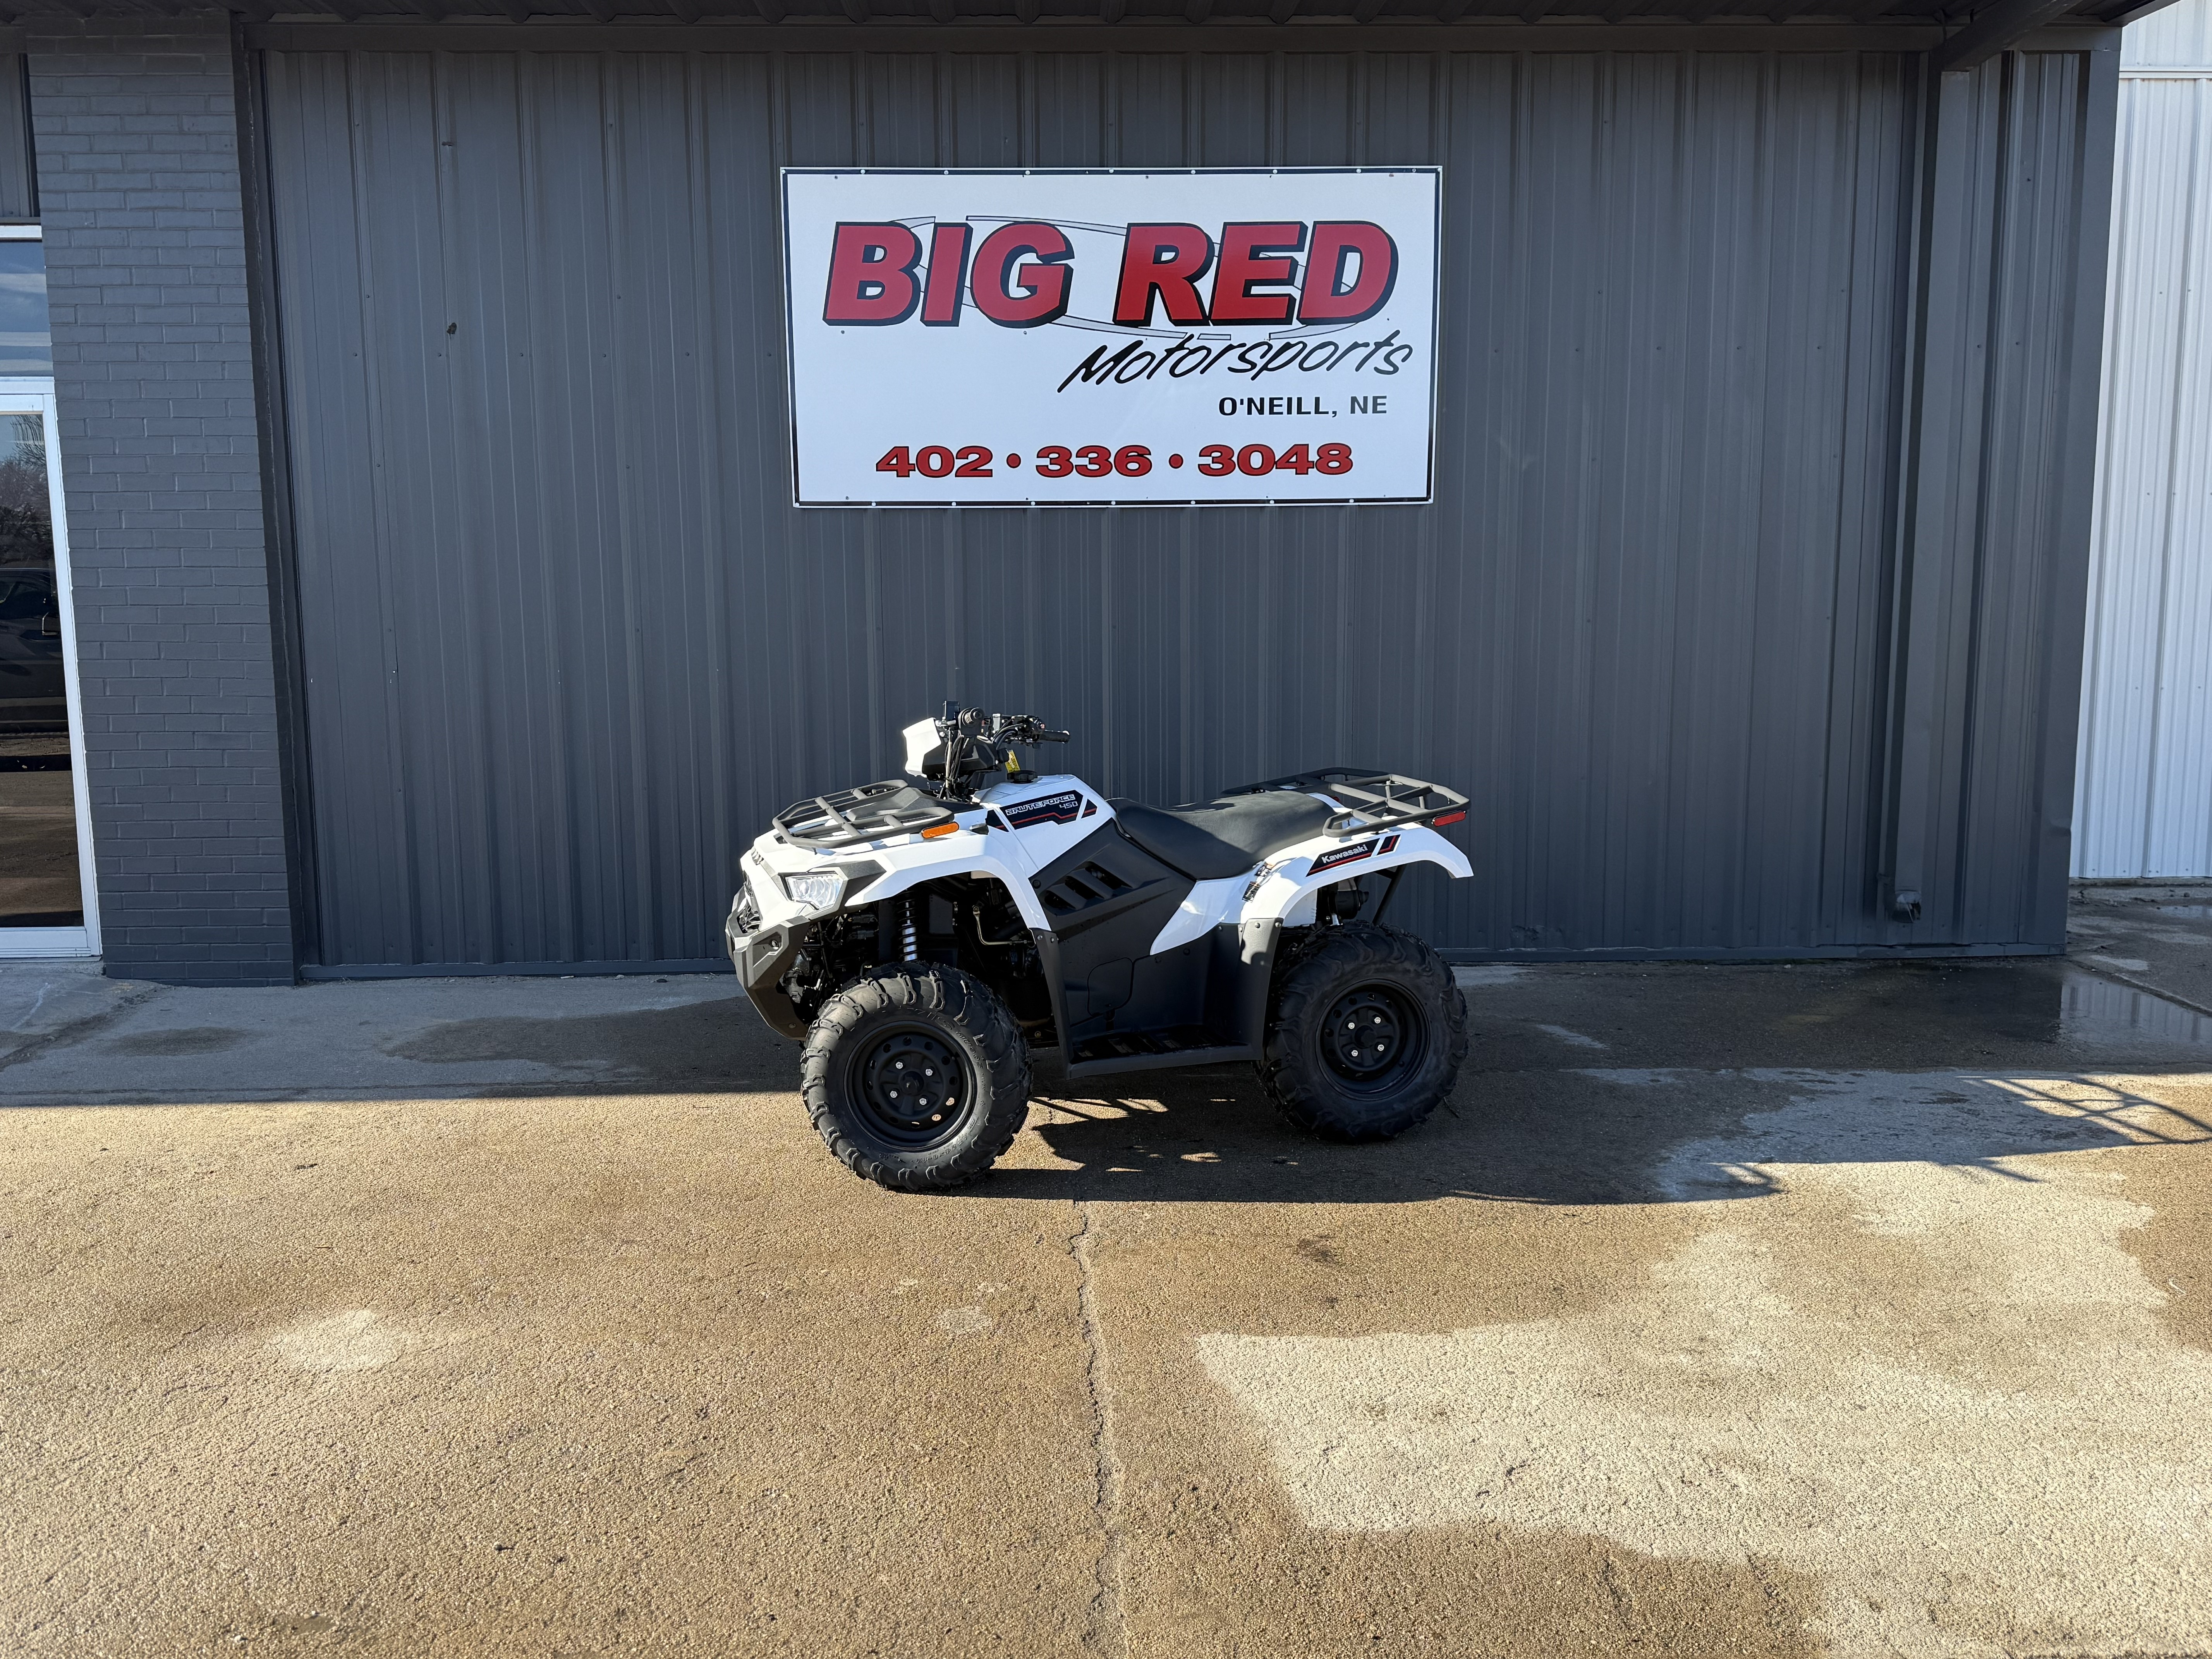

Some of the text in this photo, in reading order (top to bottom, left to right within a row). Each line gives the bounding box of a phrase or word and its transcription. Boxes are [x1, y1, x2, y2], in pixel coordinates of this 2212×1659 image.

[822, 221, 1399, 328] BIG RED
[1057, 330, 1413, 393] Motorsports
[1219, 396, 1388, 417] O'NEILL, NE
[876, 443, 1353, 478] 402 336 3048
[1321, 844, 1368, 863] Kawasaki
